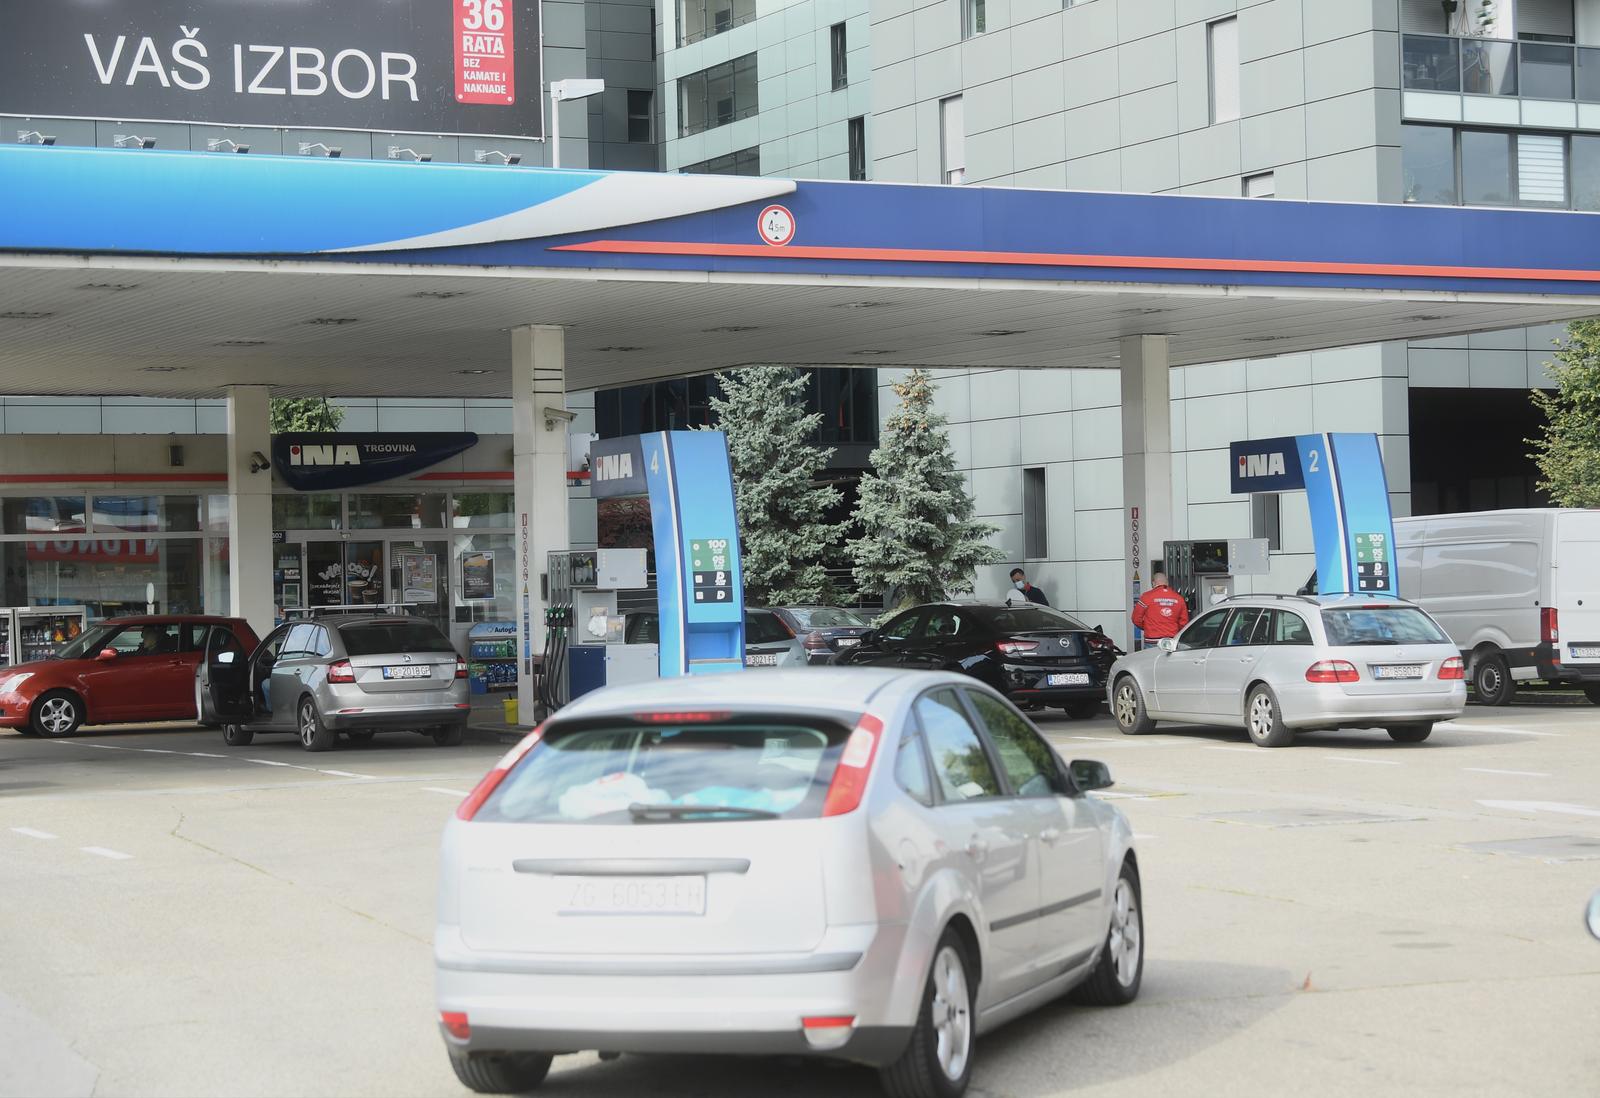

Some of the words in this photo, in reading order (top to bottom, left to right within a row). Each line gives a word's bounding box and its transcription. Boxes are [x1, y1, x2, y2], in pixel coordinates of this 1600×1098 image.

[463, 0, 504, 31] 36
[462, 35, 504, 54] RATA
[84, 25, 210, 91] VAŠ
[233, 44, 419, 102] IZBOR
[463, 58, 481, 68] BEZ
[463, 70, 500, 82] KAMATE
[502, 72, 506, 82] I
[463, 83, 506, 94] NAKNADE
[289, 445, 361, 466] INA
[363, 444, 416, 453] TRGOVINA
[650, 449, 659, 475] 4
[1239, 452, 1286, 478] INA
[1309, 449, 1319, 473] 2
[596, 452, 633, 481] INA
[707, 539, 727, 549] 100
[1369, 533, 1384, 542] 100
[1376, 579, 1384, 588] D
[716, 590, 726, 600] D
[568, 882, 596, 907] ZG
